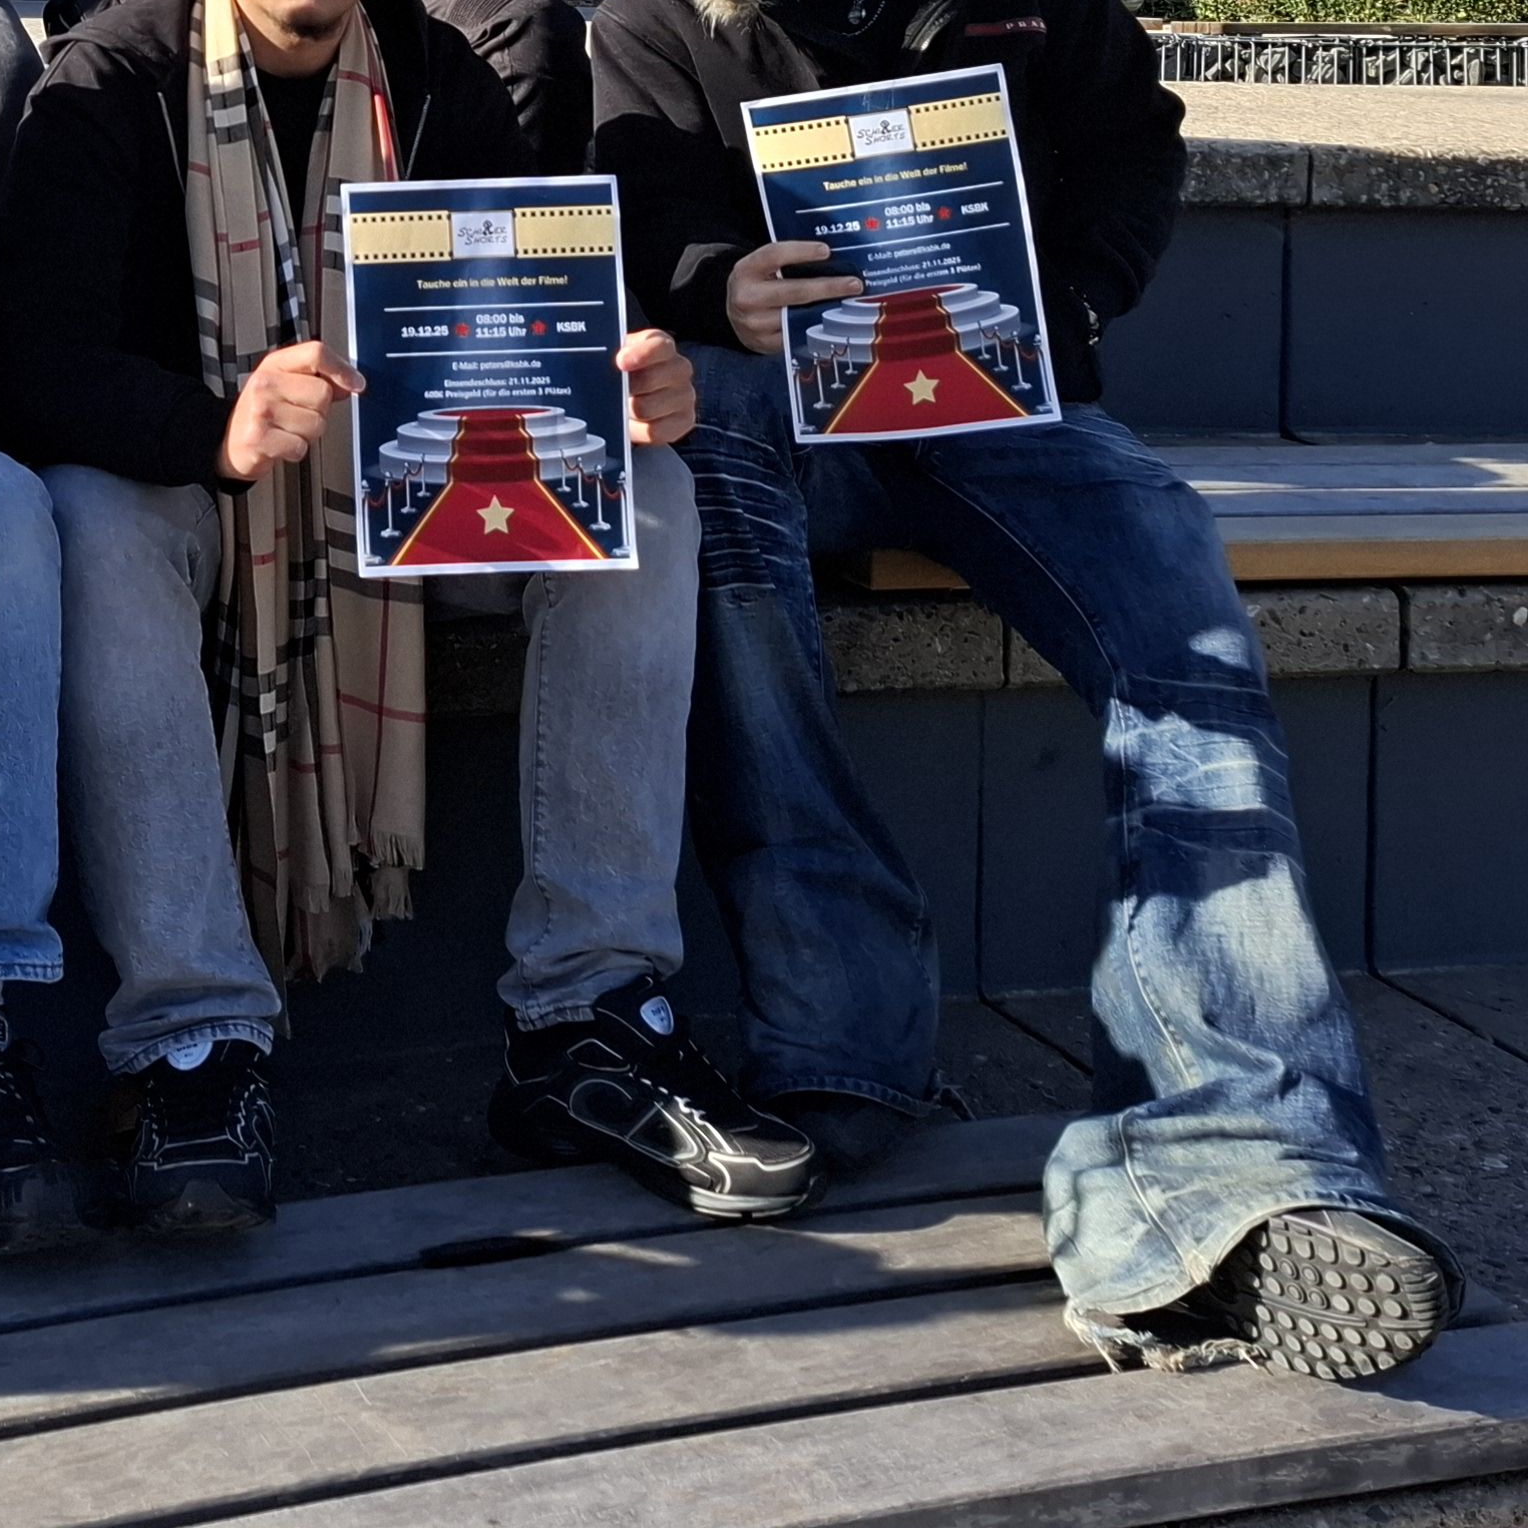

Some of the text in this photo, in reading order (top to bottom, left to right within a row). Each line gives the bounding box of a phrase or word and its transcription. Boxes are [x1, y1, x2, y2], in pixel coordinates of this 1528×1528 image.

[823, 162, 968, 191] Tauche ein in die Welt der Filme!
[916, 202, 932, 212] bis
[916, 214, 934, 224] Uhr
[416, 274, 568, 290] Tauche ein in die Welt der Filme!
[508, 313, 525, 324] bis
[401, 325, 449, 338] 19.12.25
[475, 326, 527, 338] 11:15 Uhr
[556, 321, 586, 332] KSBK
